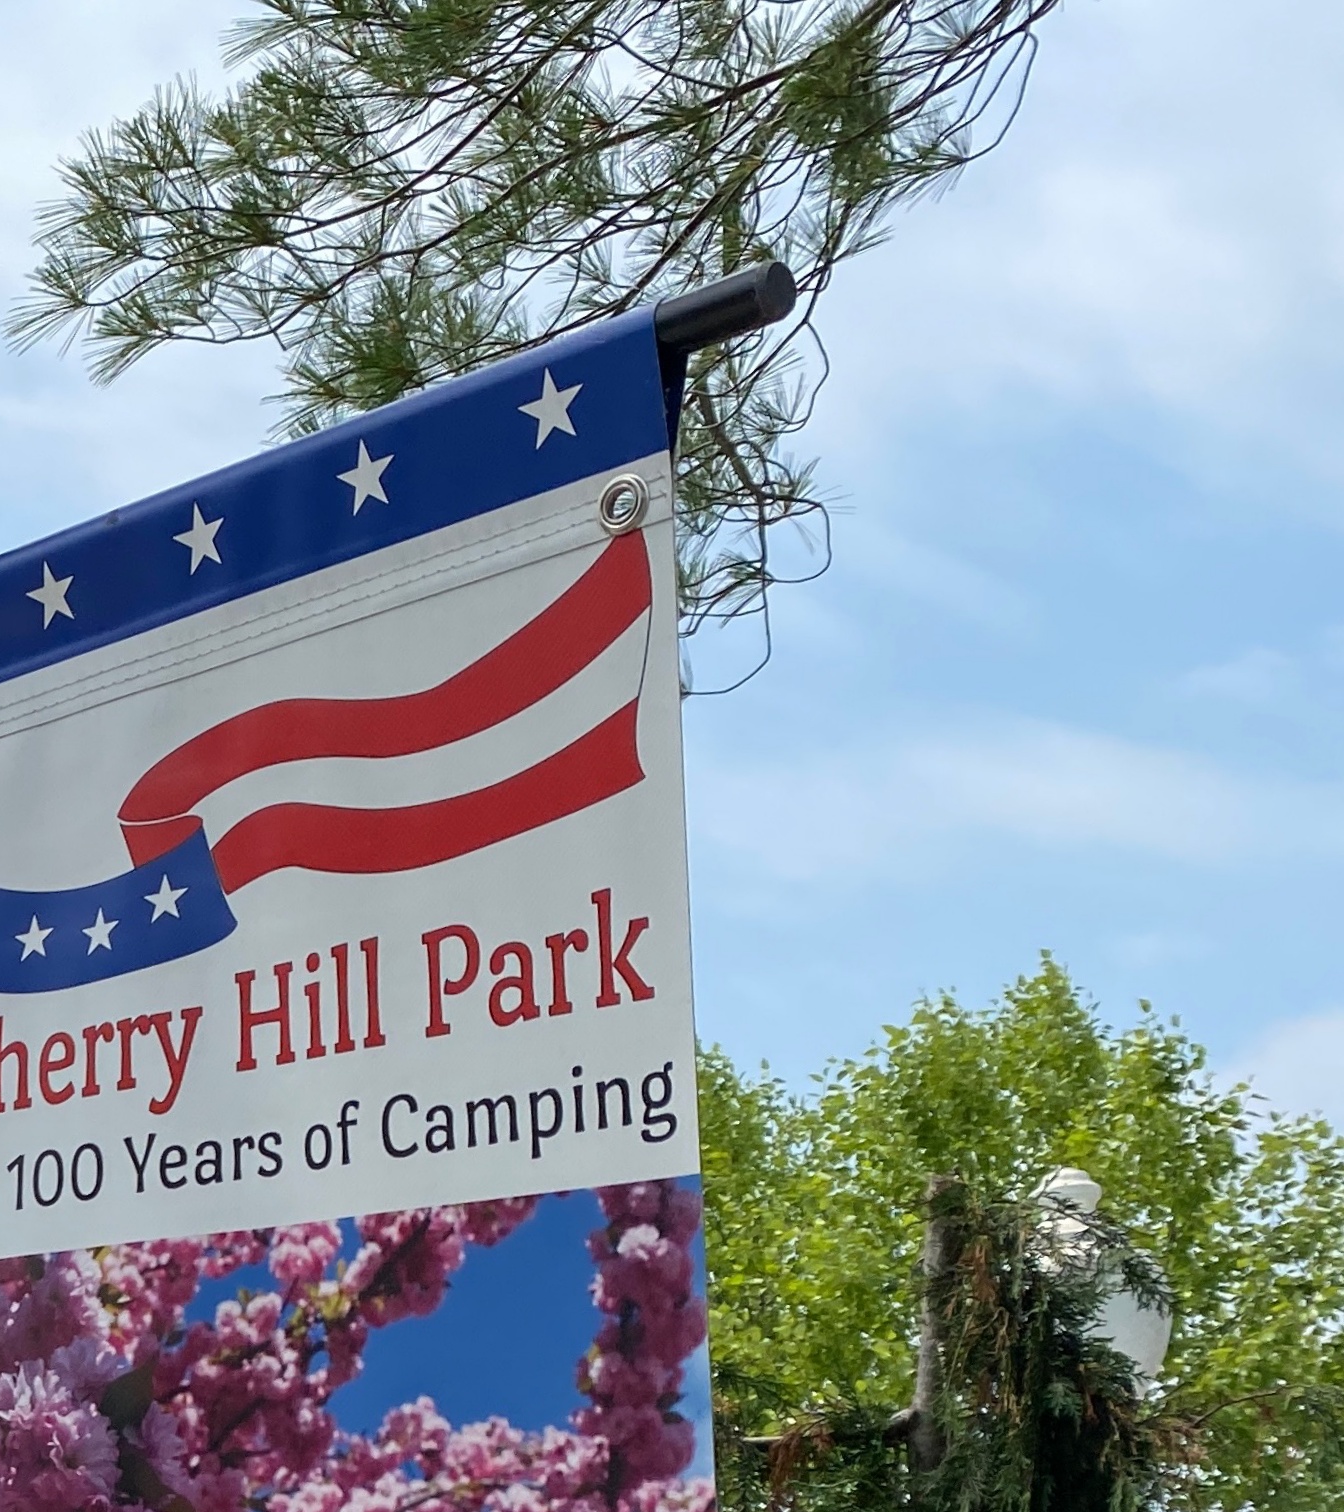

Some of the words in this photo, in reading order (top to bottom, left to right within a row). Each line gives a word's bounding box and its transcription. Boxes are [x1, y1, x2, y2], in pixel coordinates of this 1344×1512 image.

[237, 937, 383, 1070] Hill
[423, 888, 652, 1036] Park
[7, 1143, 103, 1210] 100
[124, 1132, 282, 1193] Years
[305, 1100, 359, 1170] of
[382, 1062, 677, 1159] Camping
